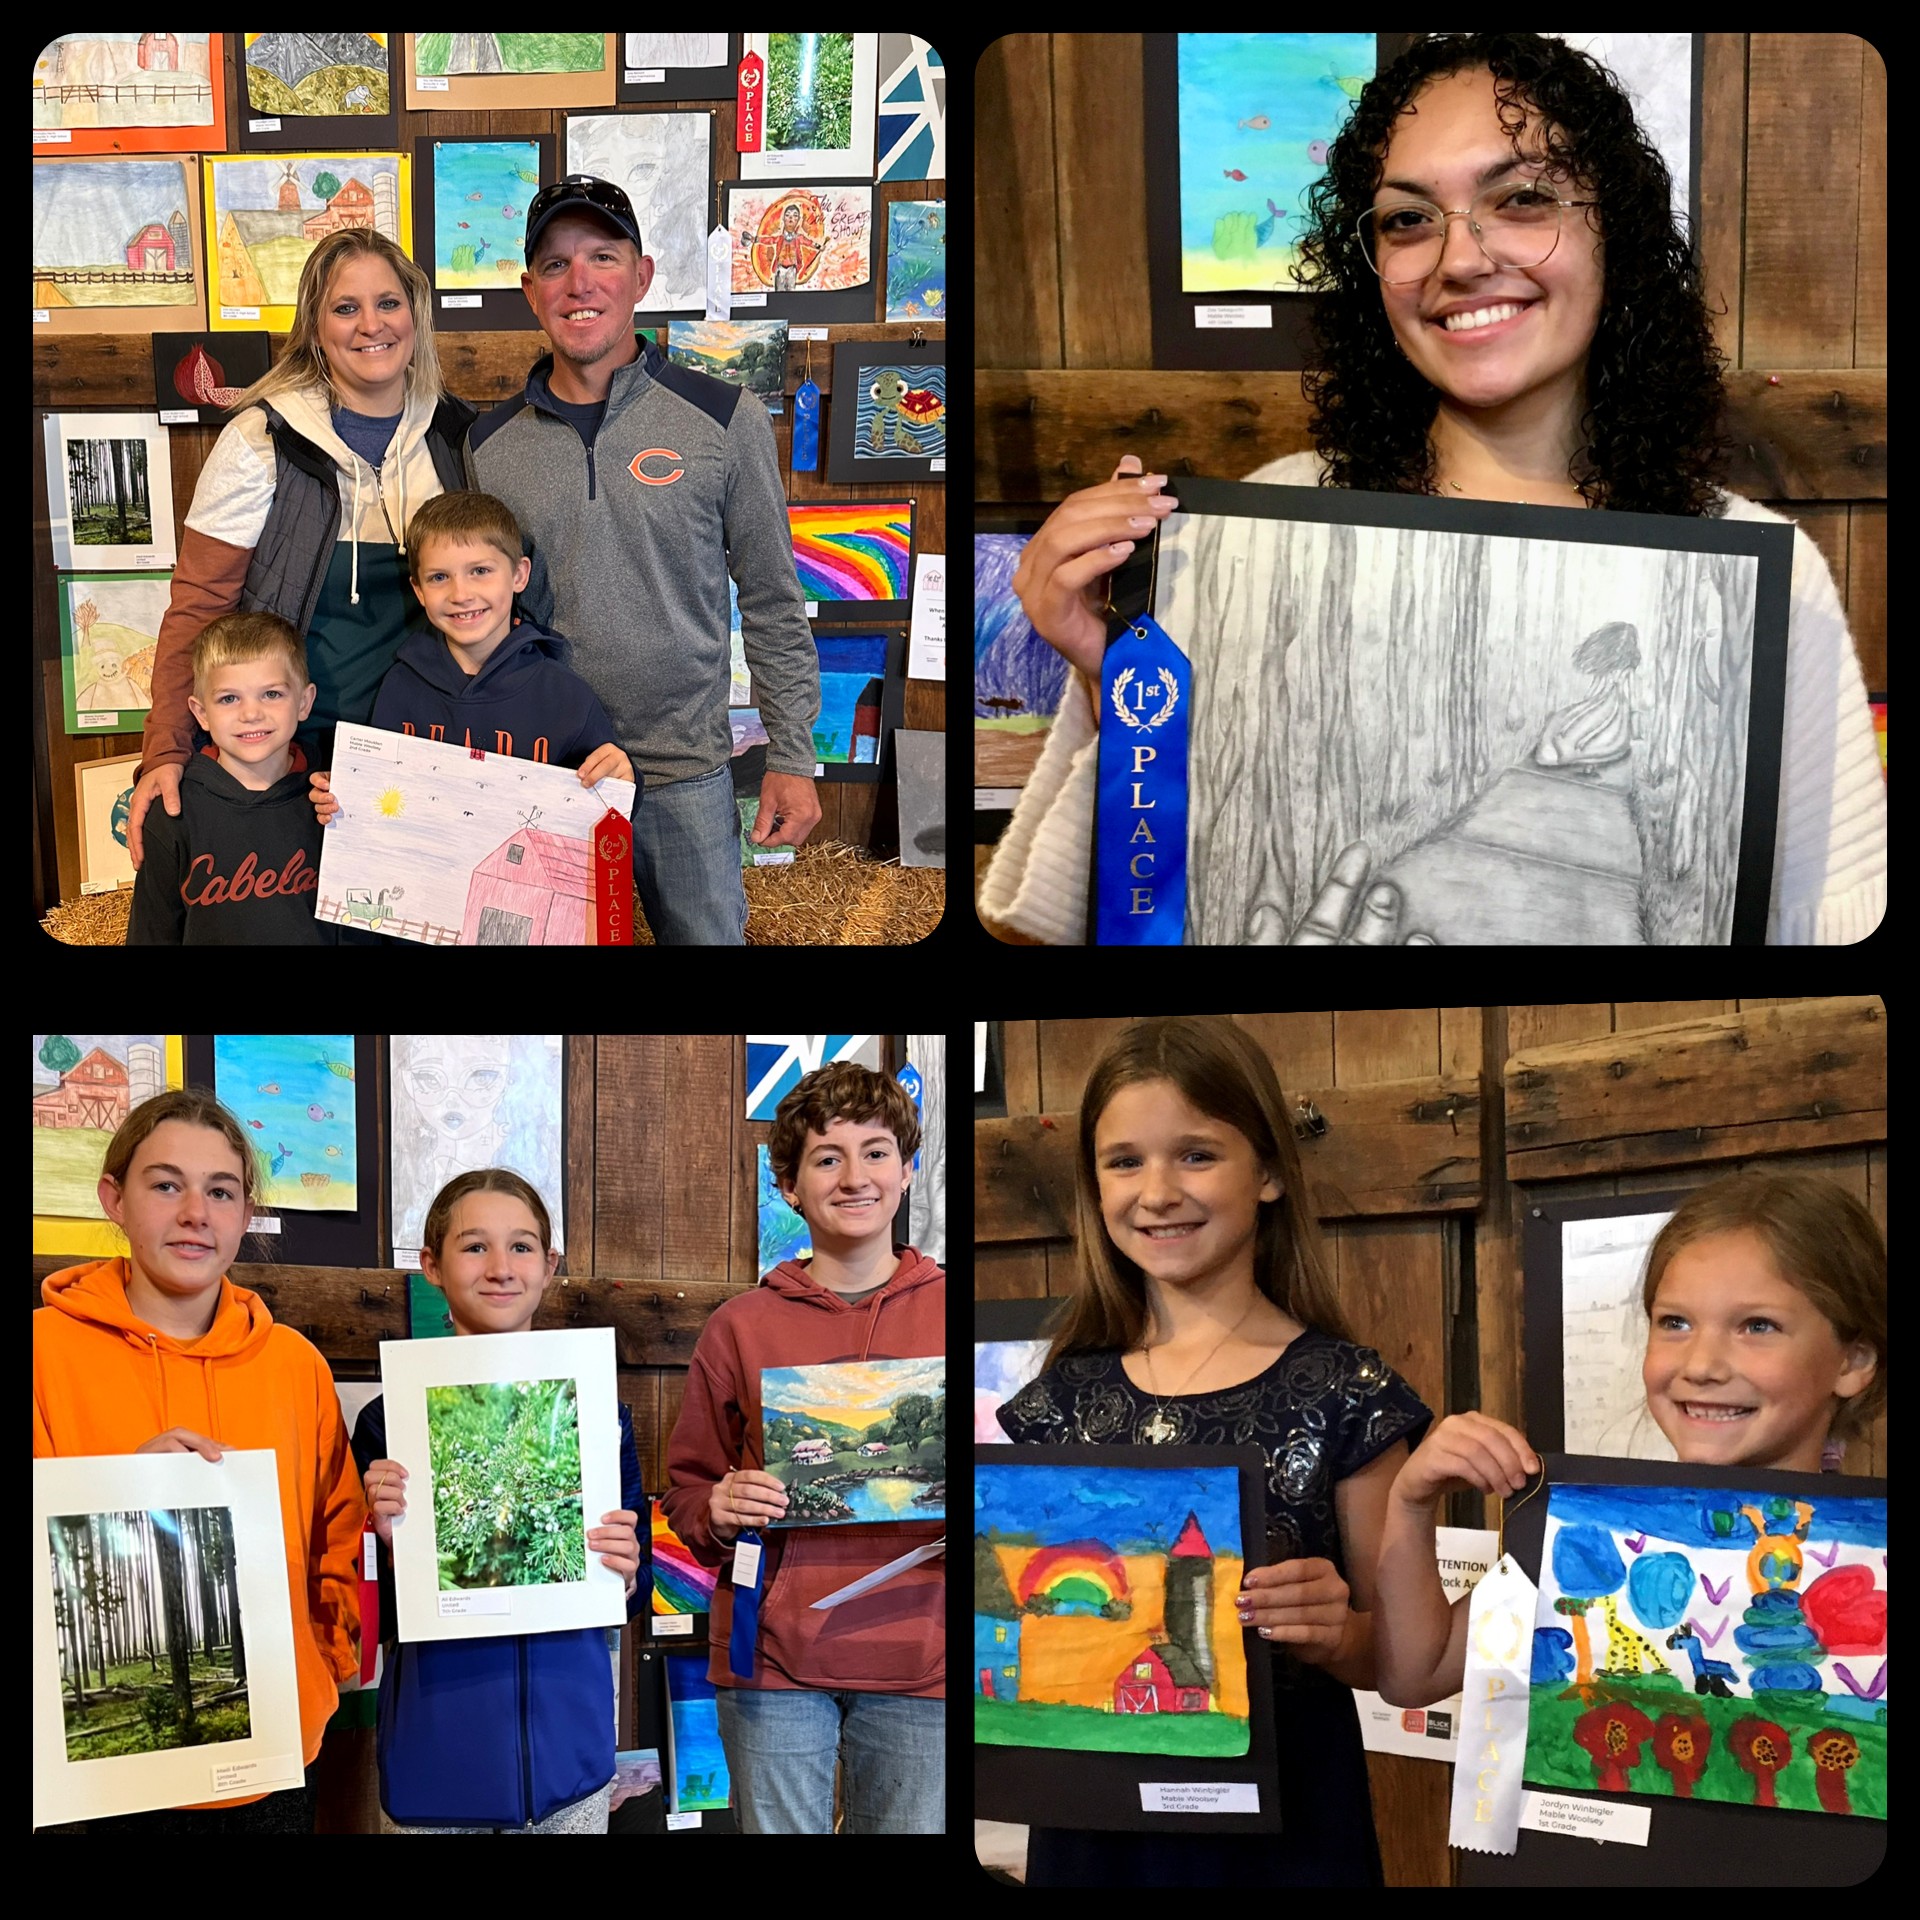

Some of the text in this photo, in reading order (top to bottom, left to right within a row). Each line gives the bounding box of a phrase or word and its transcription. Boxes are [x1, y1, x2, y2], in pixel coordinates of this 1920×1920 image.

[744, 91, 755, 143] PLACE
[1133, 680, 1161, 710] 1st
[1129, 745, 1157, 915] PLACE
[606, 840, 620, 854] 2nd
[608, 867, 621, 943] PLACE
[1440, 1576, 1461, 1588] ock
[1473, 1676, 1506, 1824] PLACE
[232, 1763, 256, 1771] Edwards
[1160, 1786, 1230, 1795] Hannah Winbigler
[1187, 1795, 1219, 1803] Woolsey
[1540, 1799, 1615, 1817] Jordyn Winbigler
[1538, 1819, 1577, 1832] 1st Grade
[1539, 1808, 1605, 1827] Mable Woolsey
